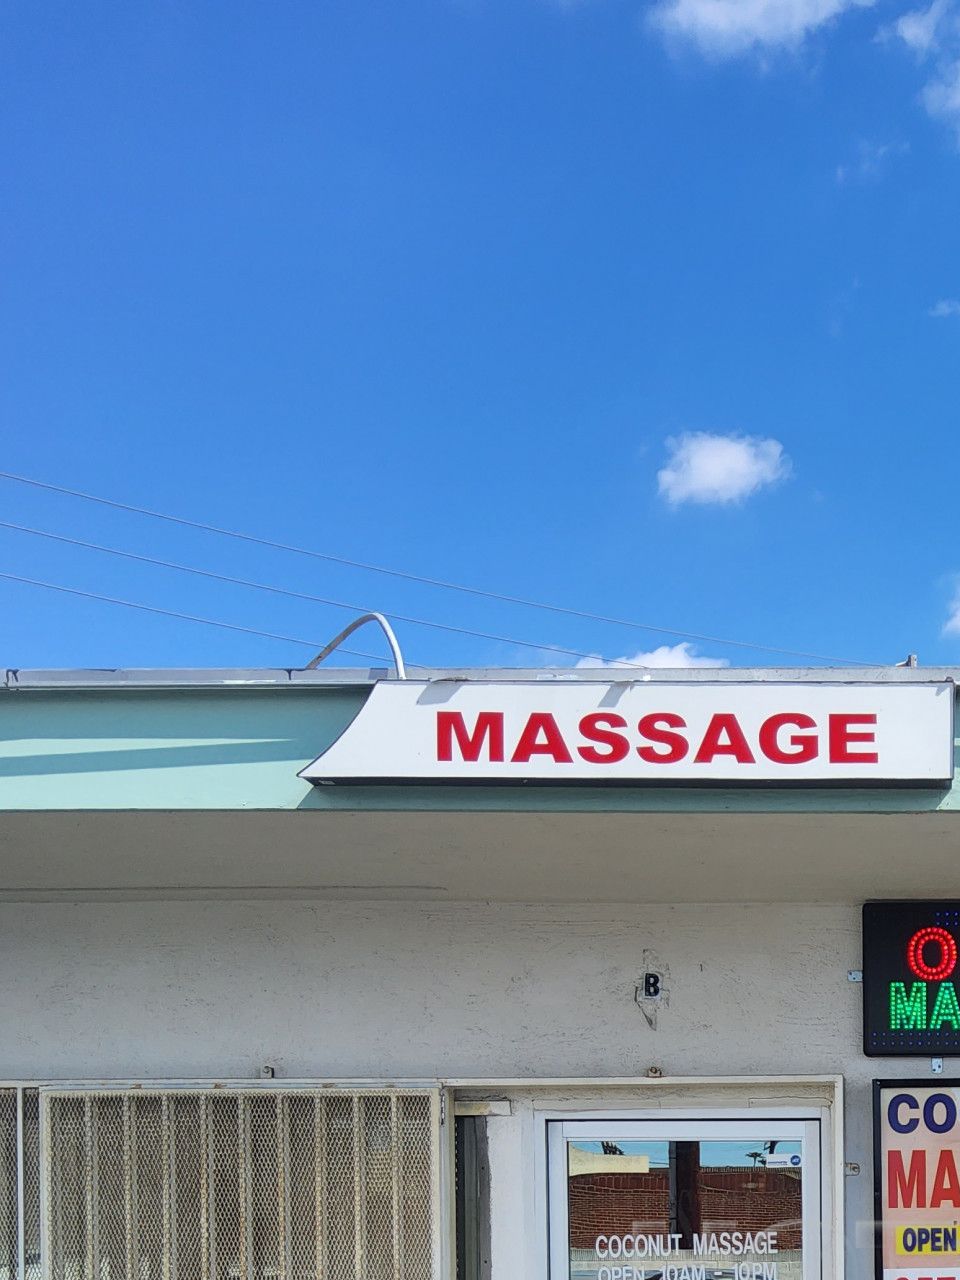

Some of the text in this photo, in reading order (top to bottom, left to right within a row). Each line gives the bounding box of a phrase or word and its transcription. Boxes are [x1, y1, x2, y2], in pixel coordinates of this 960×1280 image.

[436, 710, 879, 764] MASSAGE
[644, 972, 660, 997] B
[595, 1231, 778, 1258] COCONUT MASSAGE
[902, 1227, 957, 1252] OPEN
